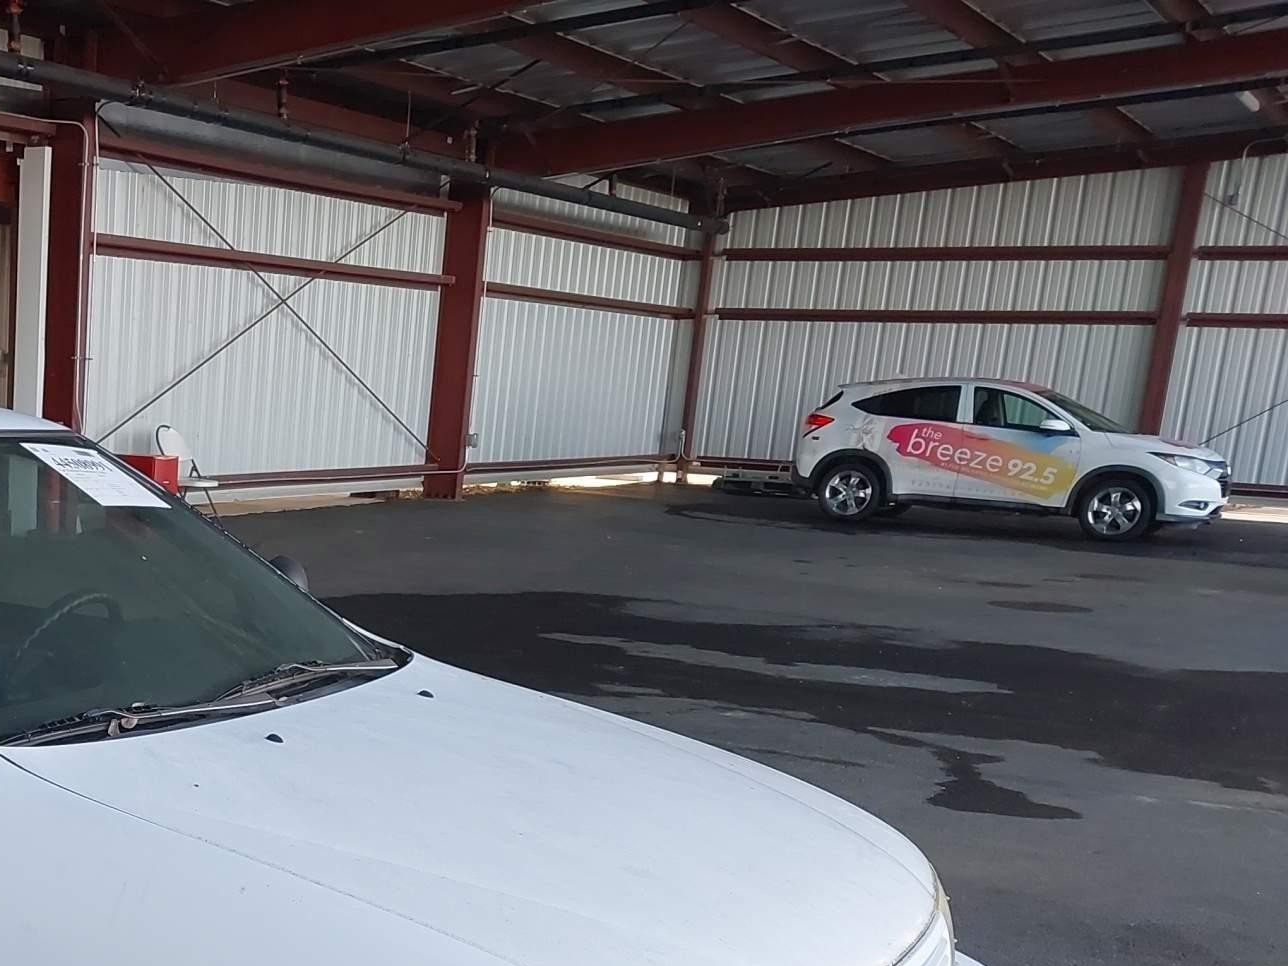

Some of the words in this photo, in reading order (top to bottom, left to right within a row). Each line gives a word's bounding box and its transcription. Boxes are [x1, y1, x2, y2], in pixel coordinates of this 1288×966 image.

[921, 427, 944, 440] the
[906, 428, 1004, 472] breeze
[1007, 458, 1058, 486] 92.5
